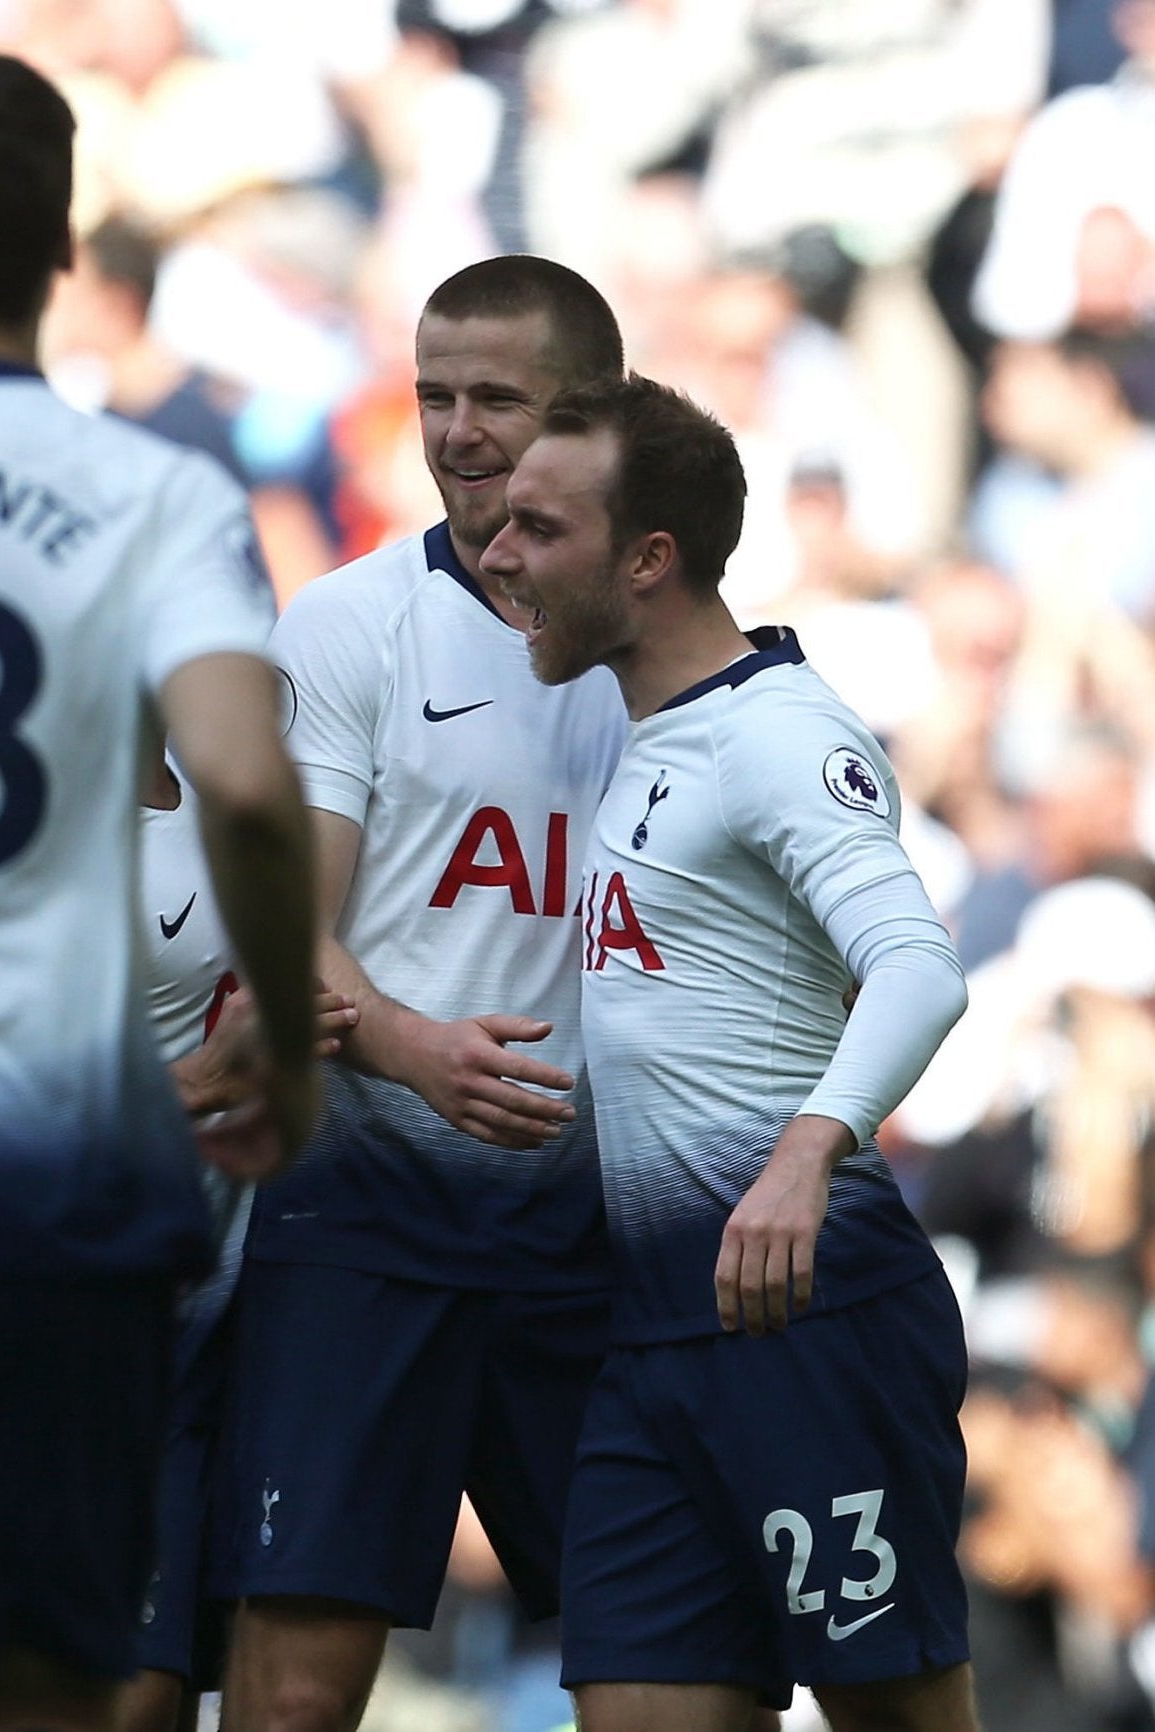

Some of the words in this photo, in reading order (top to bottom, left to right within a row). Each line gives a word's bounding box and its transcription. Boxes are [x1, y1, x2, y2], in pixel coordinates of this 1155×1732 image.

[428, 806, 582, 917] AI
[586, 871, 666, 971] IA
[763, 1489, 897, 1615] 23
